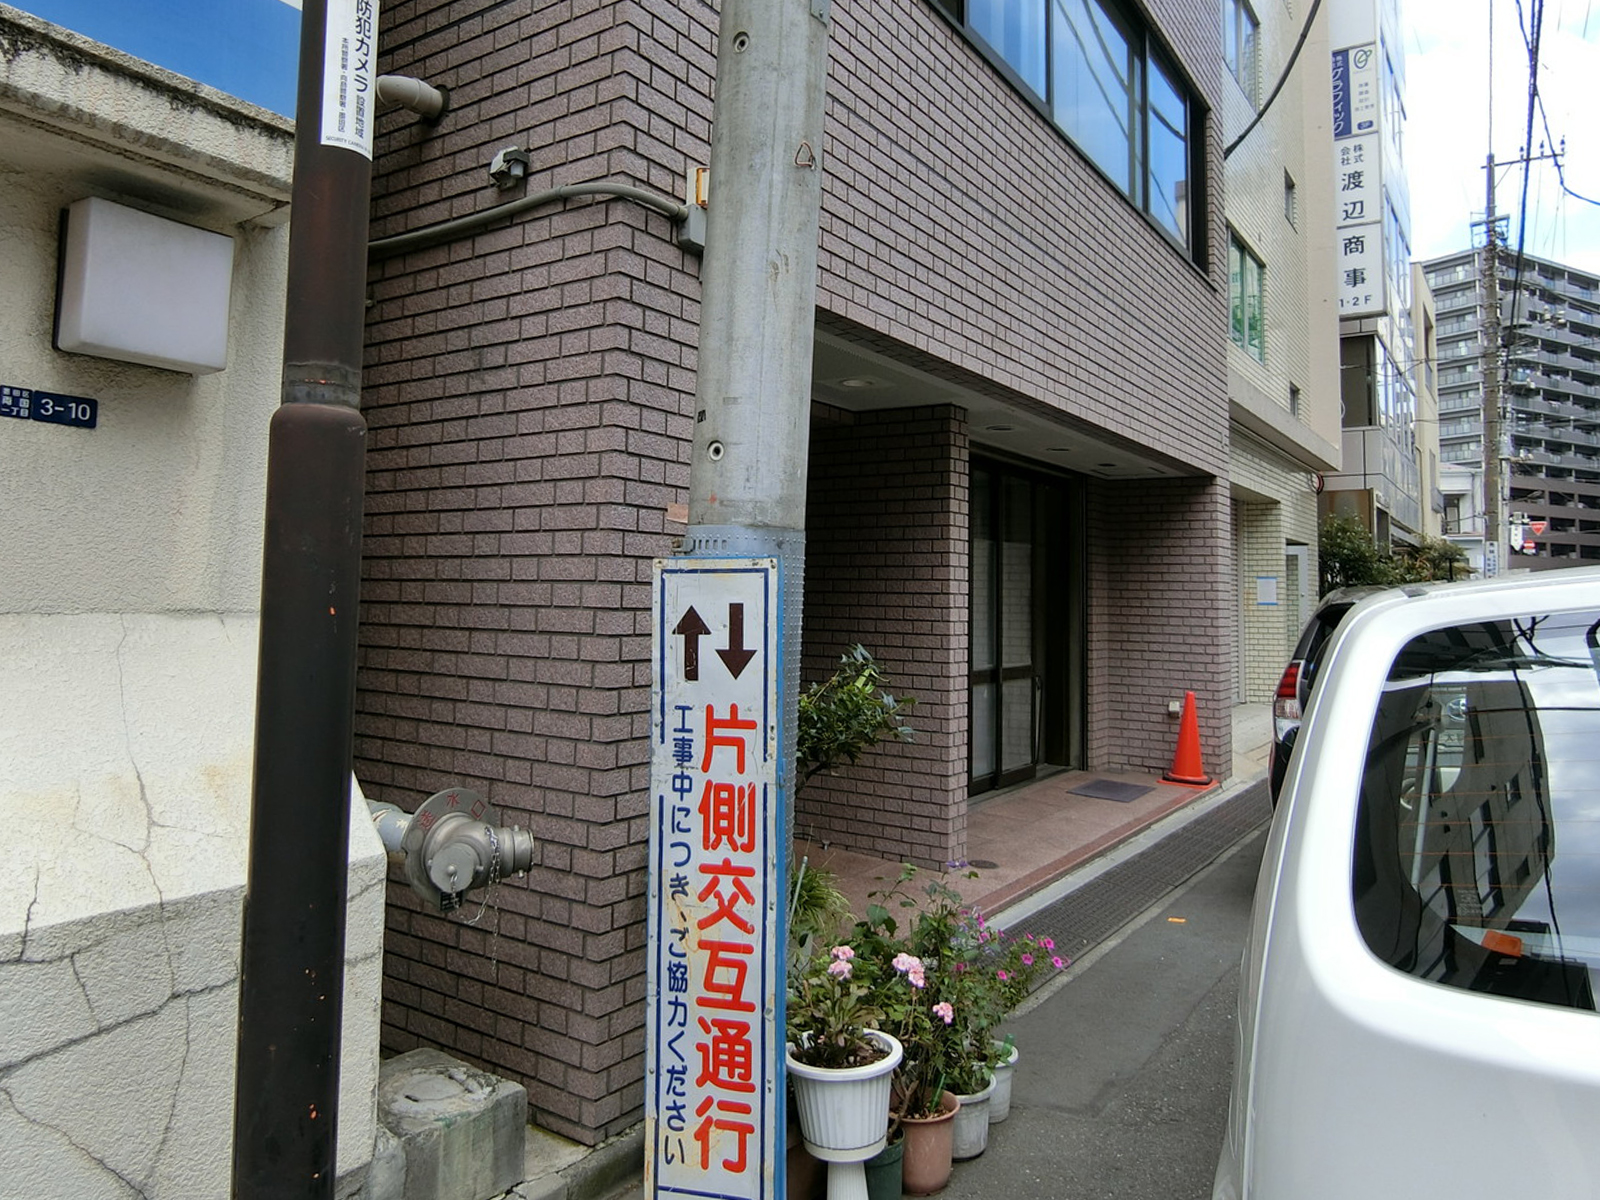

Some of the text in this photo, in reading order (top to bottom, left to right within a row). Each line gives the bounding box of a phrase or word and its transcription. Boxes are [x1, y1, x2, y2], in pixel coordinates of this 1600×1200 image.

[40, 398, 91, 420] 3-10
[694, 703, 758, 1173] 片側交互通行
